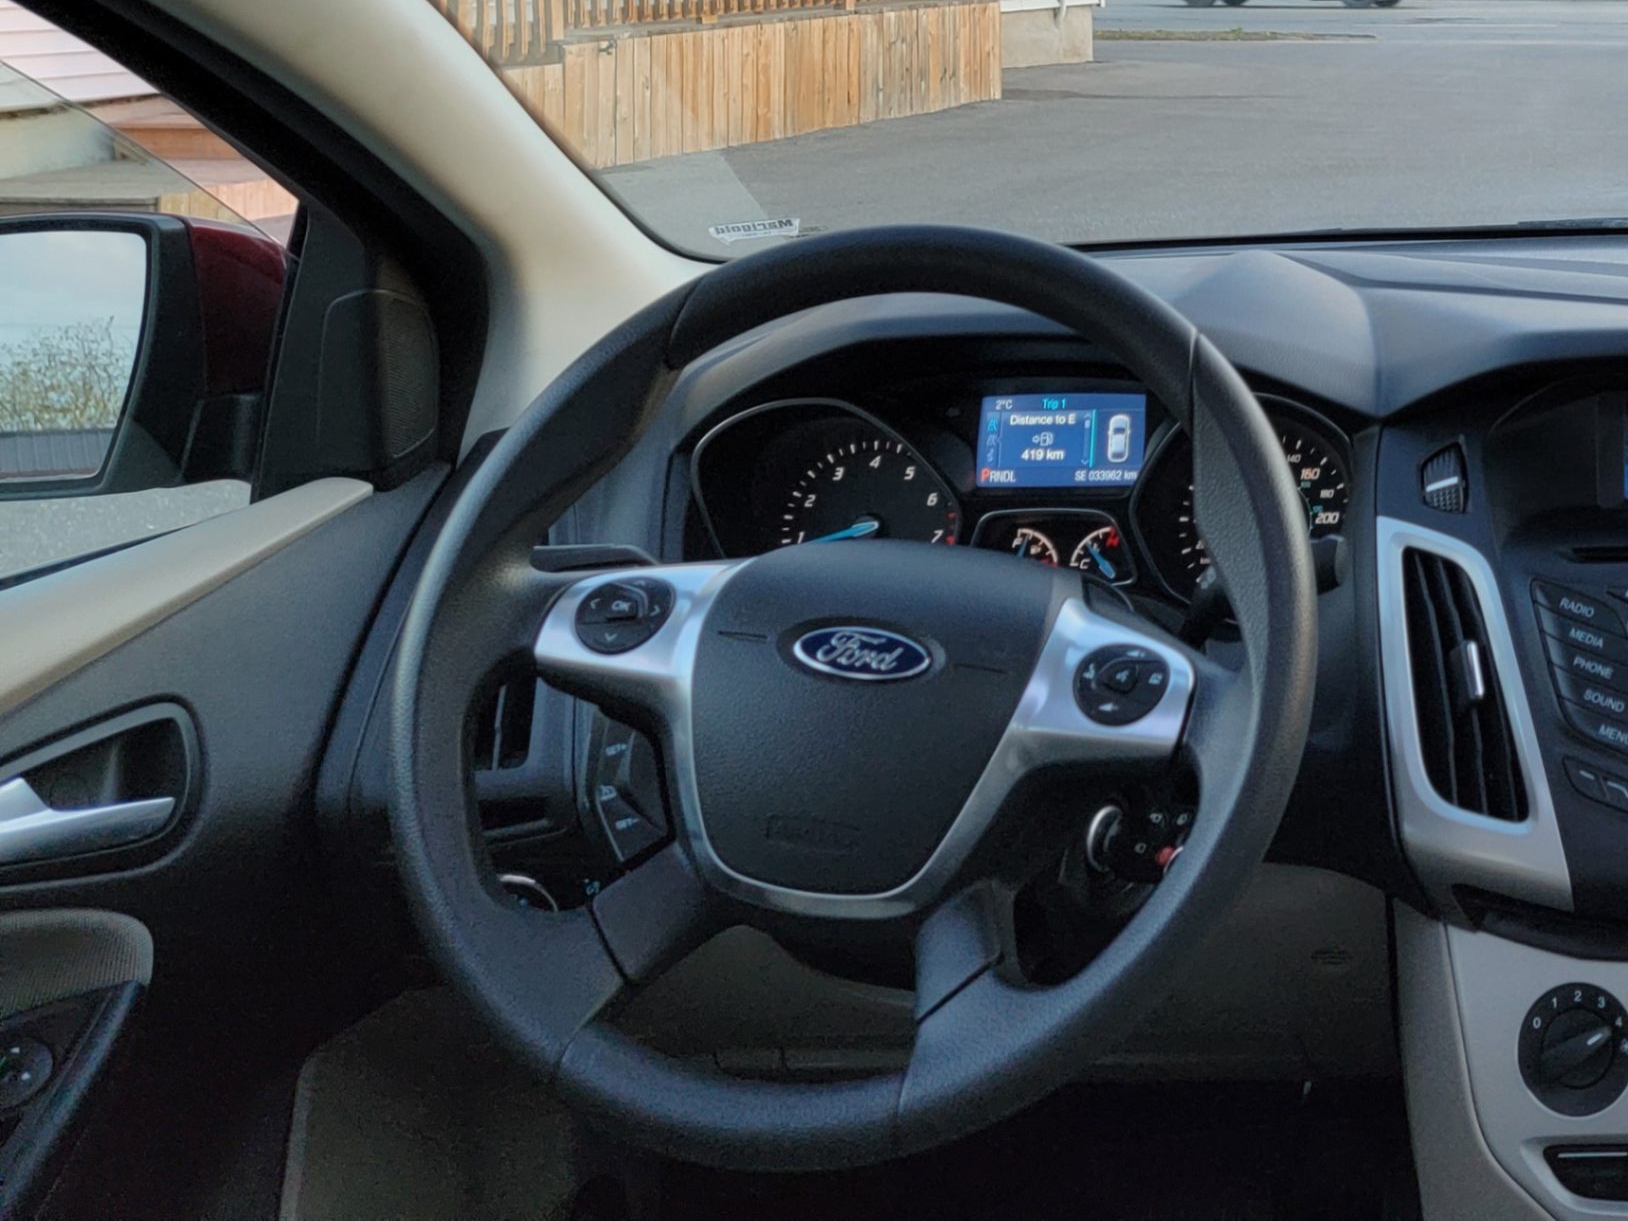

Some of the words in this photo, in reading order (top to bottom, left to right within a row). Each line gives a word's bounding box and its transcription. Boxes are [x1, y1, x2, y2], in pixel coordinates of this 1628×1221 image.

[995, 399, 1013, 410] 2°C
[1042, 398, 1059, 410] Trip
[1061, 398, 1067, 409] 1
[1010, 414, 1053, 426] Distance
[1055, 415, 1066, 425] to
[1068, 415, 1076, 425] E
[1021, 448, 1044, 461] 419
[1046, 448, 1064, 461] km
[869, 455, 882, 469] 4
[832, 467, 844, 481] 3
[904, 466, 915, 480] 5
[1124, 470, 1137, 480] km
[1300, 467, 1320, 480] 160
[804, 494, 816, 508] 2
[926, 492, 938, 506] 6
[1315, 512, 1340, 525] 200
[931, 530, 943, 543] 7
[1079, 558, 1091, 569] C
[611, 599, 631, 612] OK
[1559, 596, 1595, 619] RADIO
[1569, 627, 1604, 649] MEDIA
[816, 631, 905, 672] Ford
[1573, 656, 1614, 679] PHONE
[1583, 688, 1625, 713] SOUND
[1551, 997, 1558, 1008] 1
[1573, 990, 1582, 1002] 2
[1597, 996, 1606, 1008] 3
[1532, 1017, 1541, 1029] 0
[1614, 1016, 1623, 1028] 4
